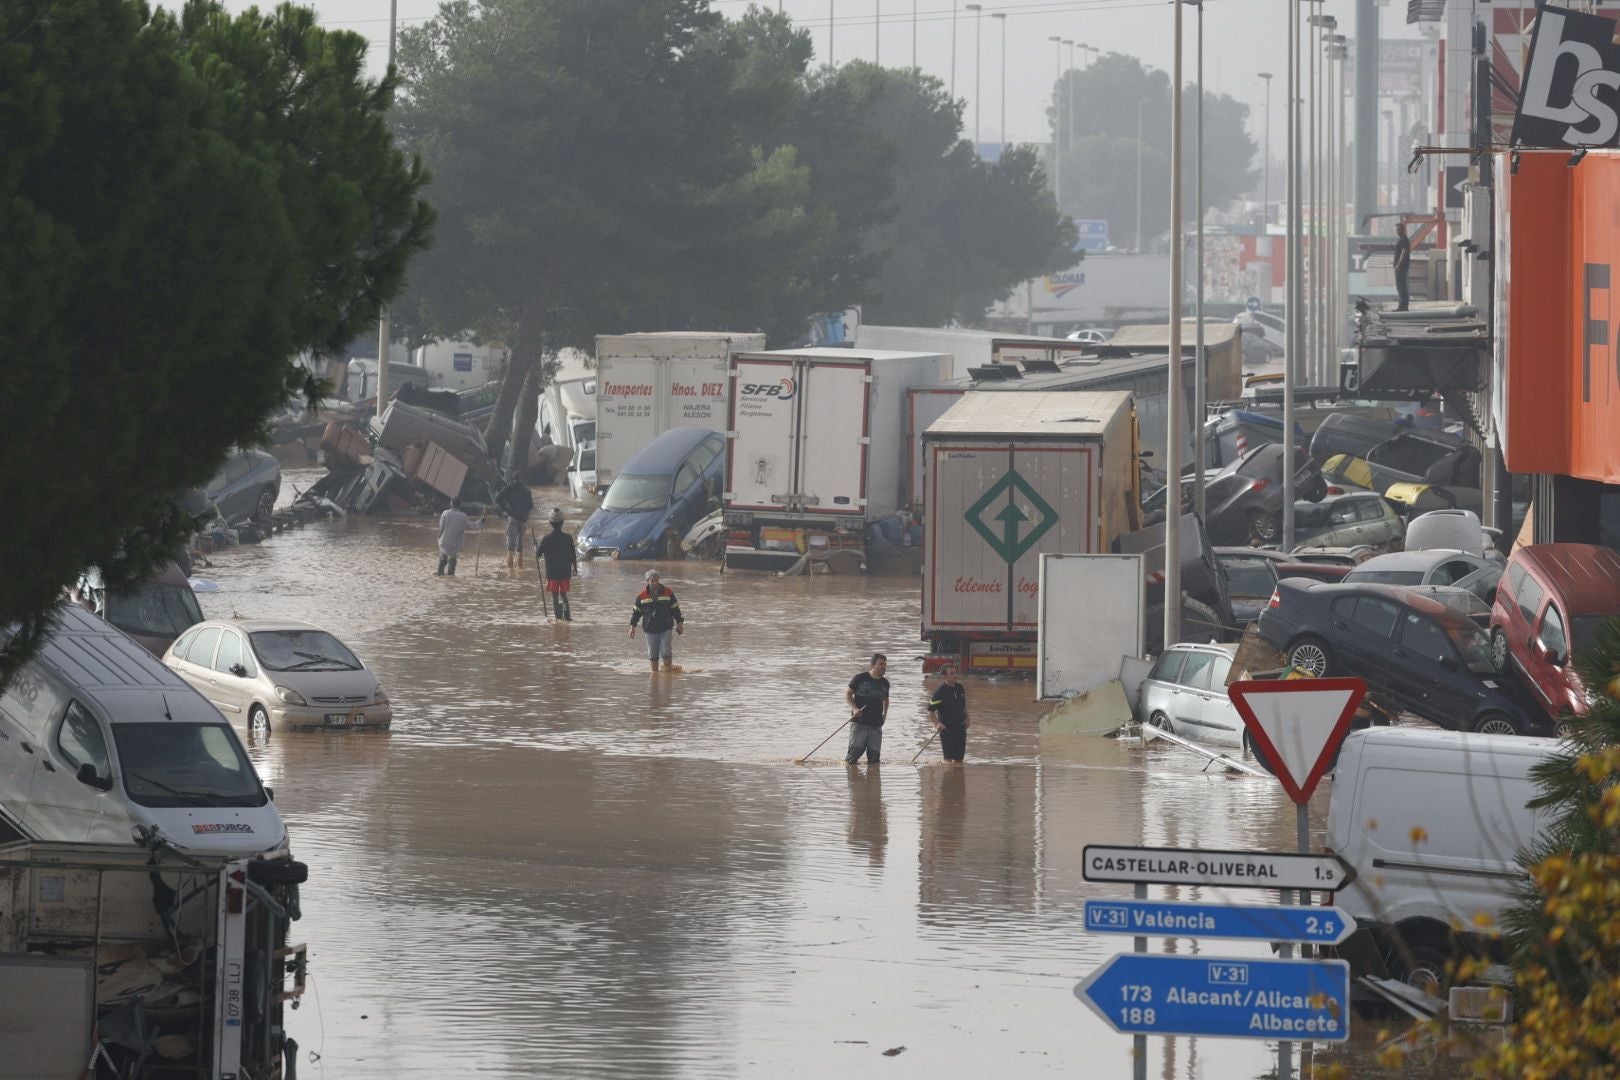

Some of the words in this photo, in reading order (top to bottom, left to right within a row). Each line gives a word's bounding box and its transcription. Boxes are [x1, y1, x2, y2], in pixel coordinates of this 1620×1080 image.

[1583, 273, 1620, 402] F
[603, 382, 653, 398] Transportes
[671, 382, 698, 397] Hnos.
[701, 383, 724, 397] DIEZ
[741, 384, 783, 396] SFB
[1093, 909, 1126, 925] V-31
[1133, 910, 1216, 930] València
[229, 963, 241, 984] LLJ
[1211, 966, 1246, 982] V-31
[1121, 985, 1152, 1003] 173
[1121, 1007, 1156, 1025] 188
[1249, 1012, 1339, 1032] Albacete
